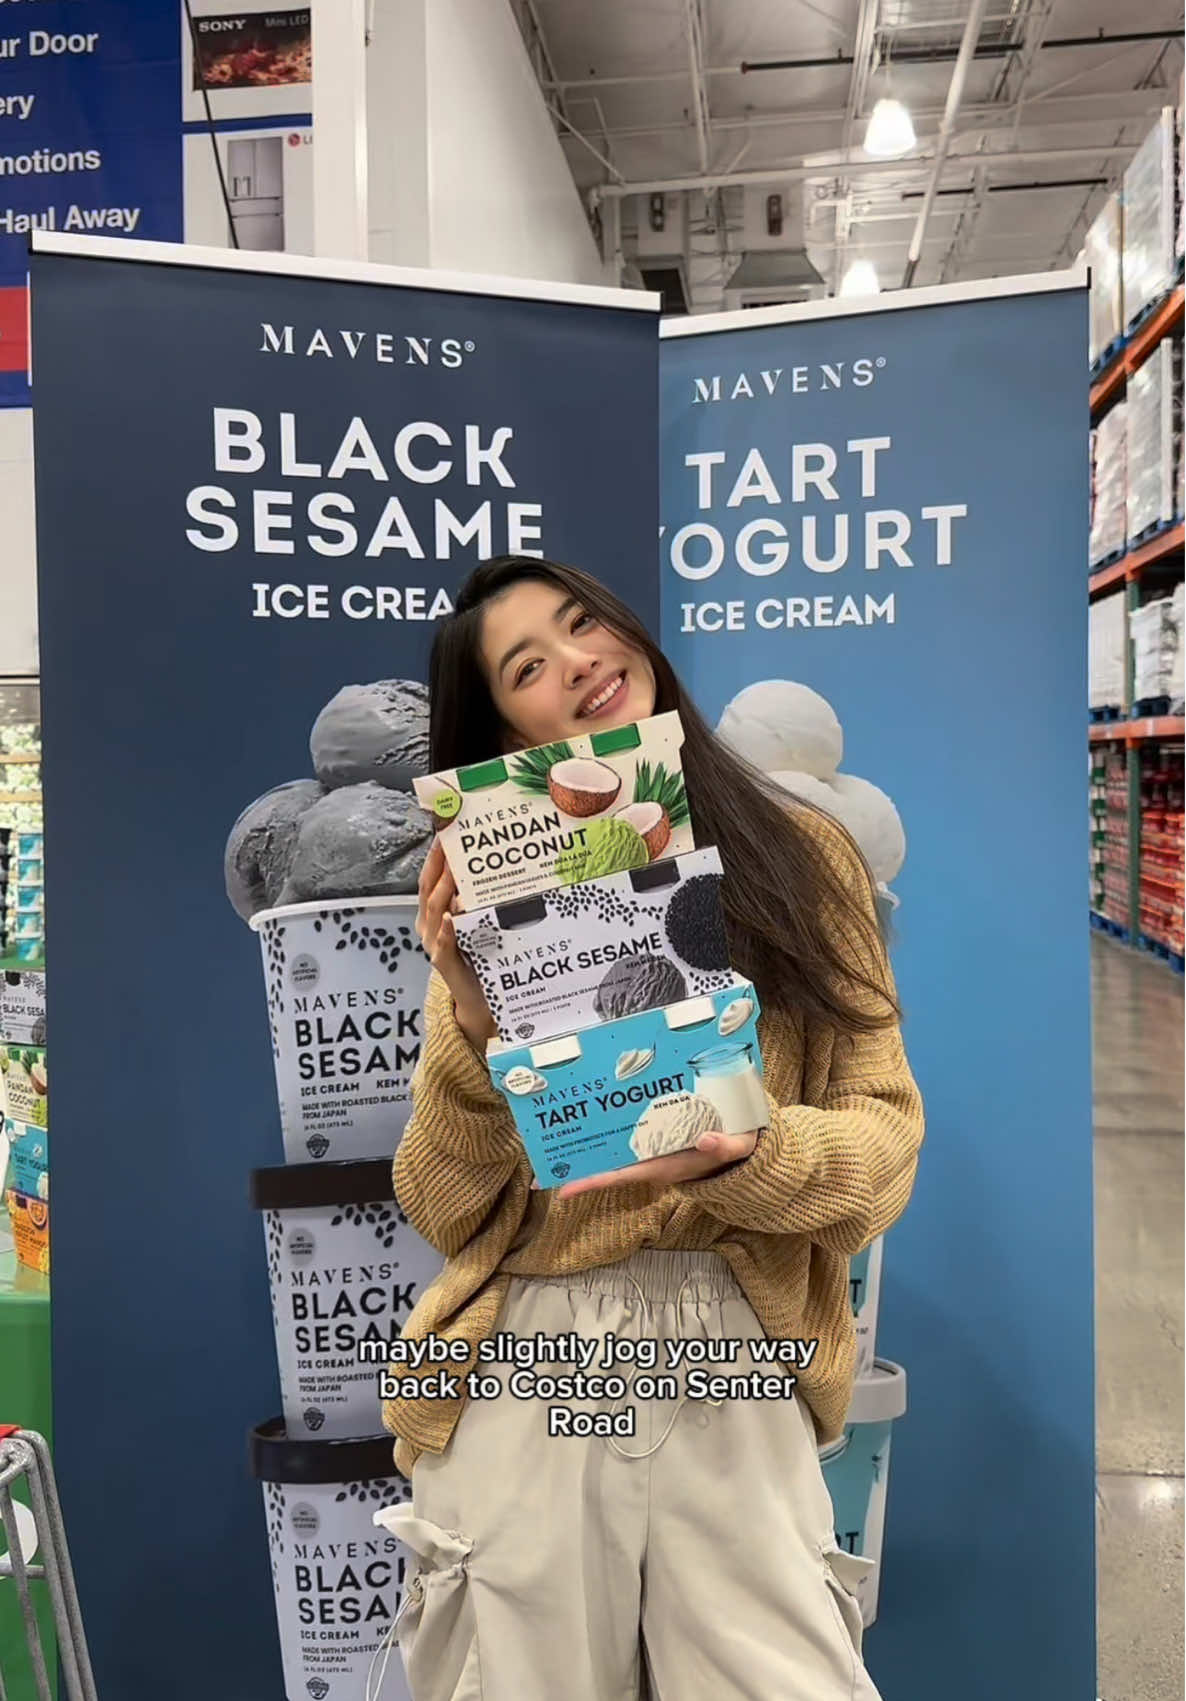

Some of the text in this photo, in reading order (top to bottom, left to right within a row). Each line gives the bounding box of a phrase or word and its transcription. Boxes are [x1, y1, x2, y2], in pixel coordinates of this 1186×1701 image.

[198, 19, 247, 33] SONY
[289, 14, 309, 26] LED
[29, 31, 99, 57] Door
[63, 205, 141, 232] Away
[213, 406, 516, 488] BLACK
[685, 435, 891, 509] TART
[185, 485, 544, 560] SESAME
[658, 504, 968, 581] OGURT
[252, 583, 454, 621] ICE CREA
[680, 592, 895, 632] ICE CREAM
[461, 812, 561, 853] PANDAN
[467, 829, 588, 875] COCONUT
[500, 931, 663, 991] BLACK SESAME
[505, 986, 546, 1003] ICE CREAM
[295, 1009, 420, 1047] BLACK
[298, 1042, 421, 1080] SESAM
[301, 1086, 317, 1097] ICE
[320, 1082, 360, 1094] CREAM
[376, 1079, 401, 1090] KEM
[321, 1100, 341, 1109] WITH
[341, 1095, 380, 1107] ROASTED
[381, 1094, 407, 1103] BLACK
[535, 1073, 686, 1129] TART YOGURT
[322, 1109, 347, 1118] JAPAN
[541, 1126, 582, 1142] ICE CREAM
[292, 1282, 417, 1321] BLACK
[298, 1358, 354, 1369] ICE CREAM
[336, 1372, 374, 1382] ROASTED
[298, 1591, 402, 1625] SESA
[300, 1630, 316, 1640] ICE
[319, 1630, 360, 1640] CREAM
[341, 1643, 379, 1654] ROASTED
